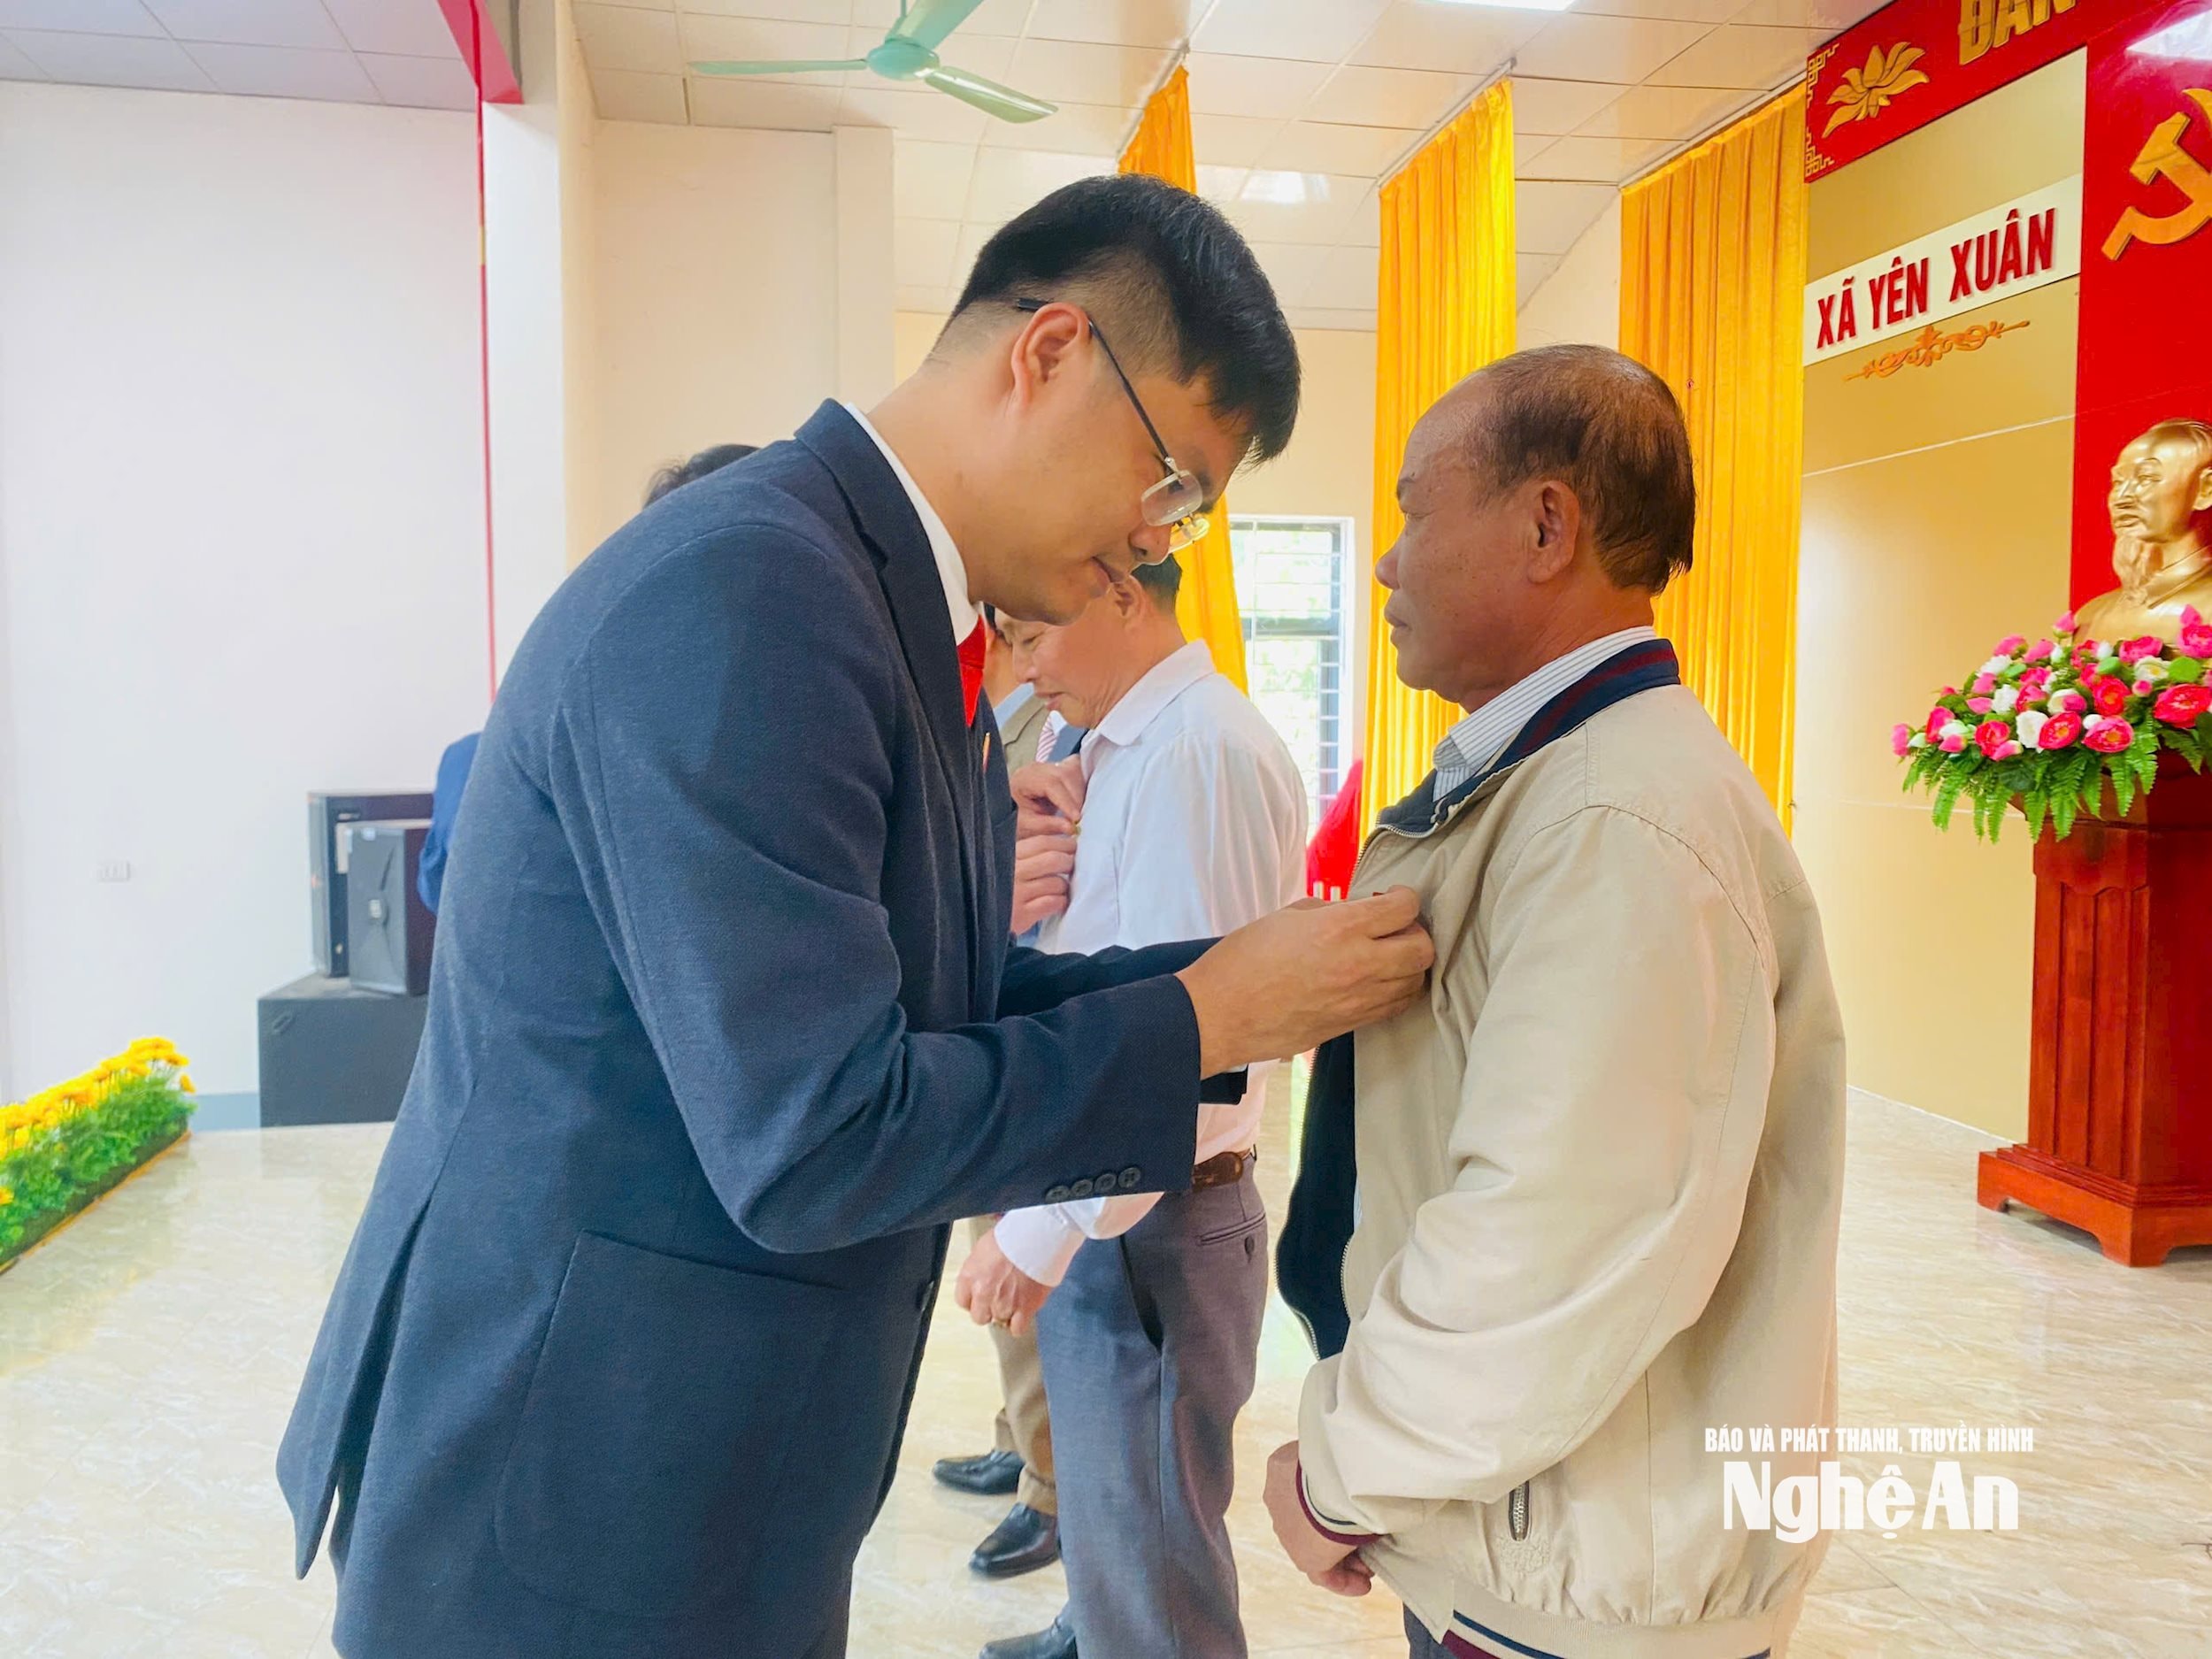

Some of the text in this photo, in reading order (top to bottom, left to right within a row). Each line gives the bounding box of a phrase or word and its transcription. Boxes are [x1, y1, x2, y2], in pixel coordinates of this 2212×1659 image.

[1816, 208, 2056, 349] XÃ YÊN XUÂN
